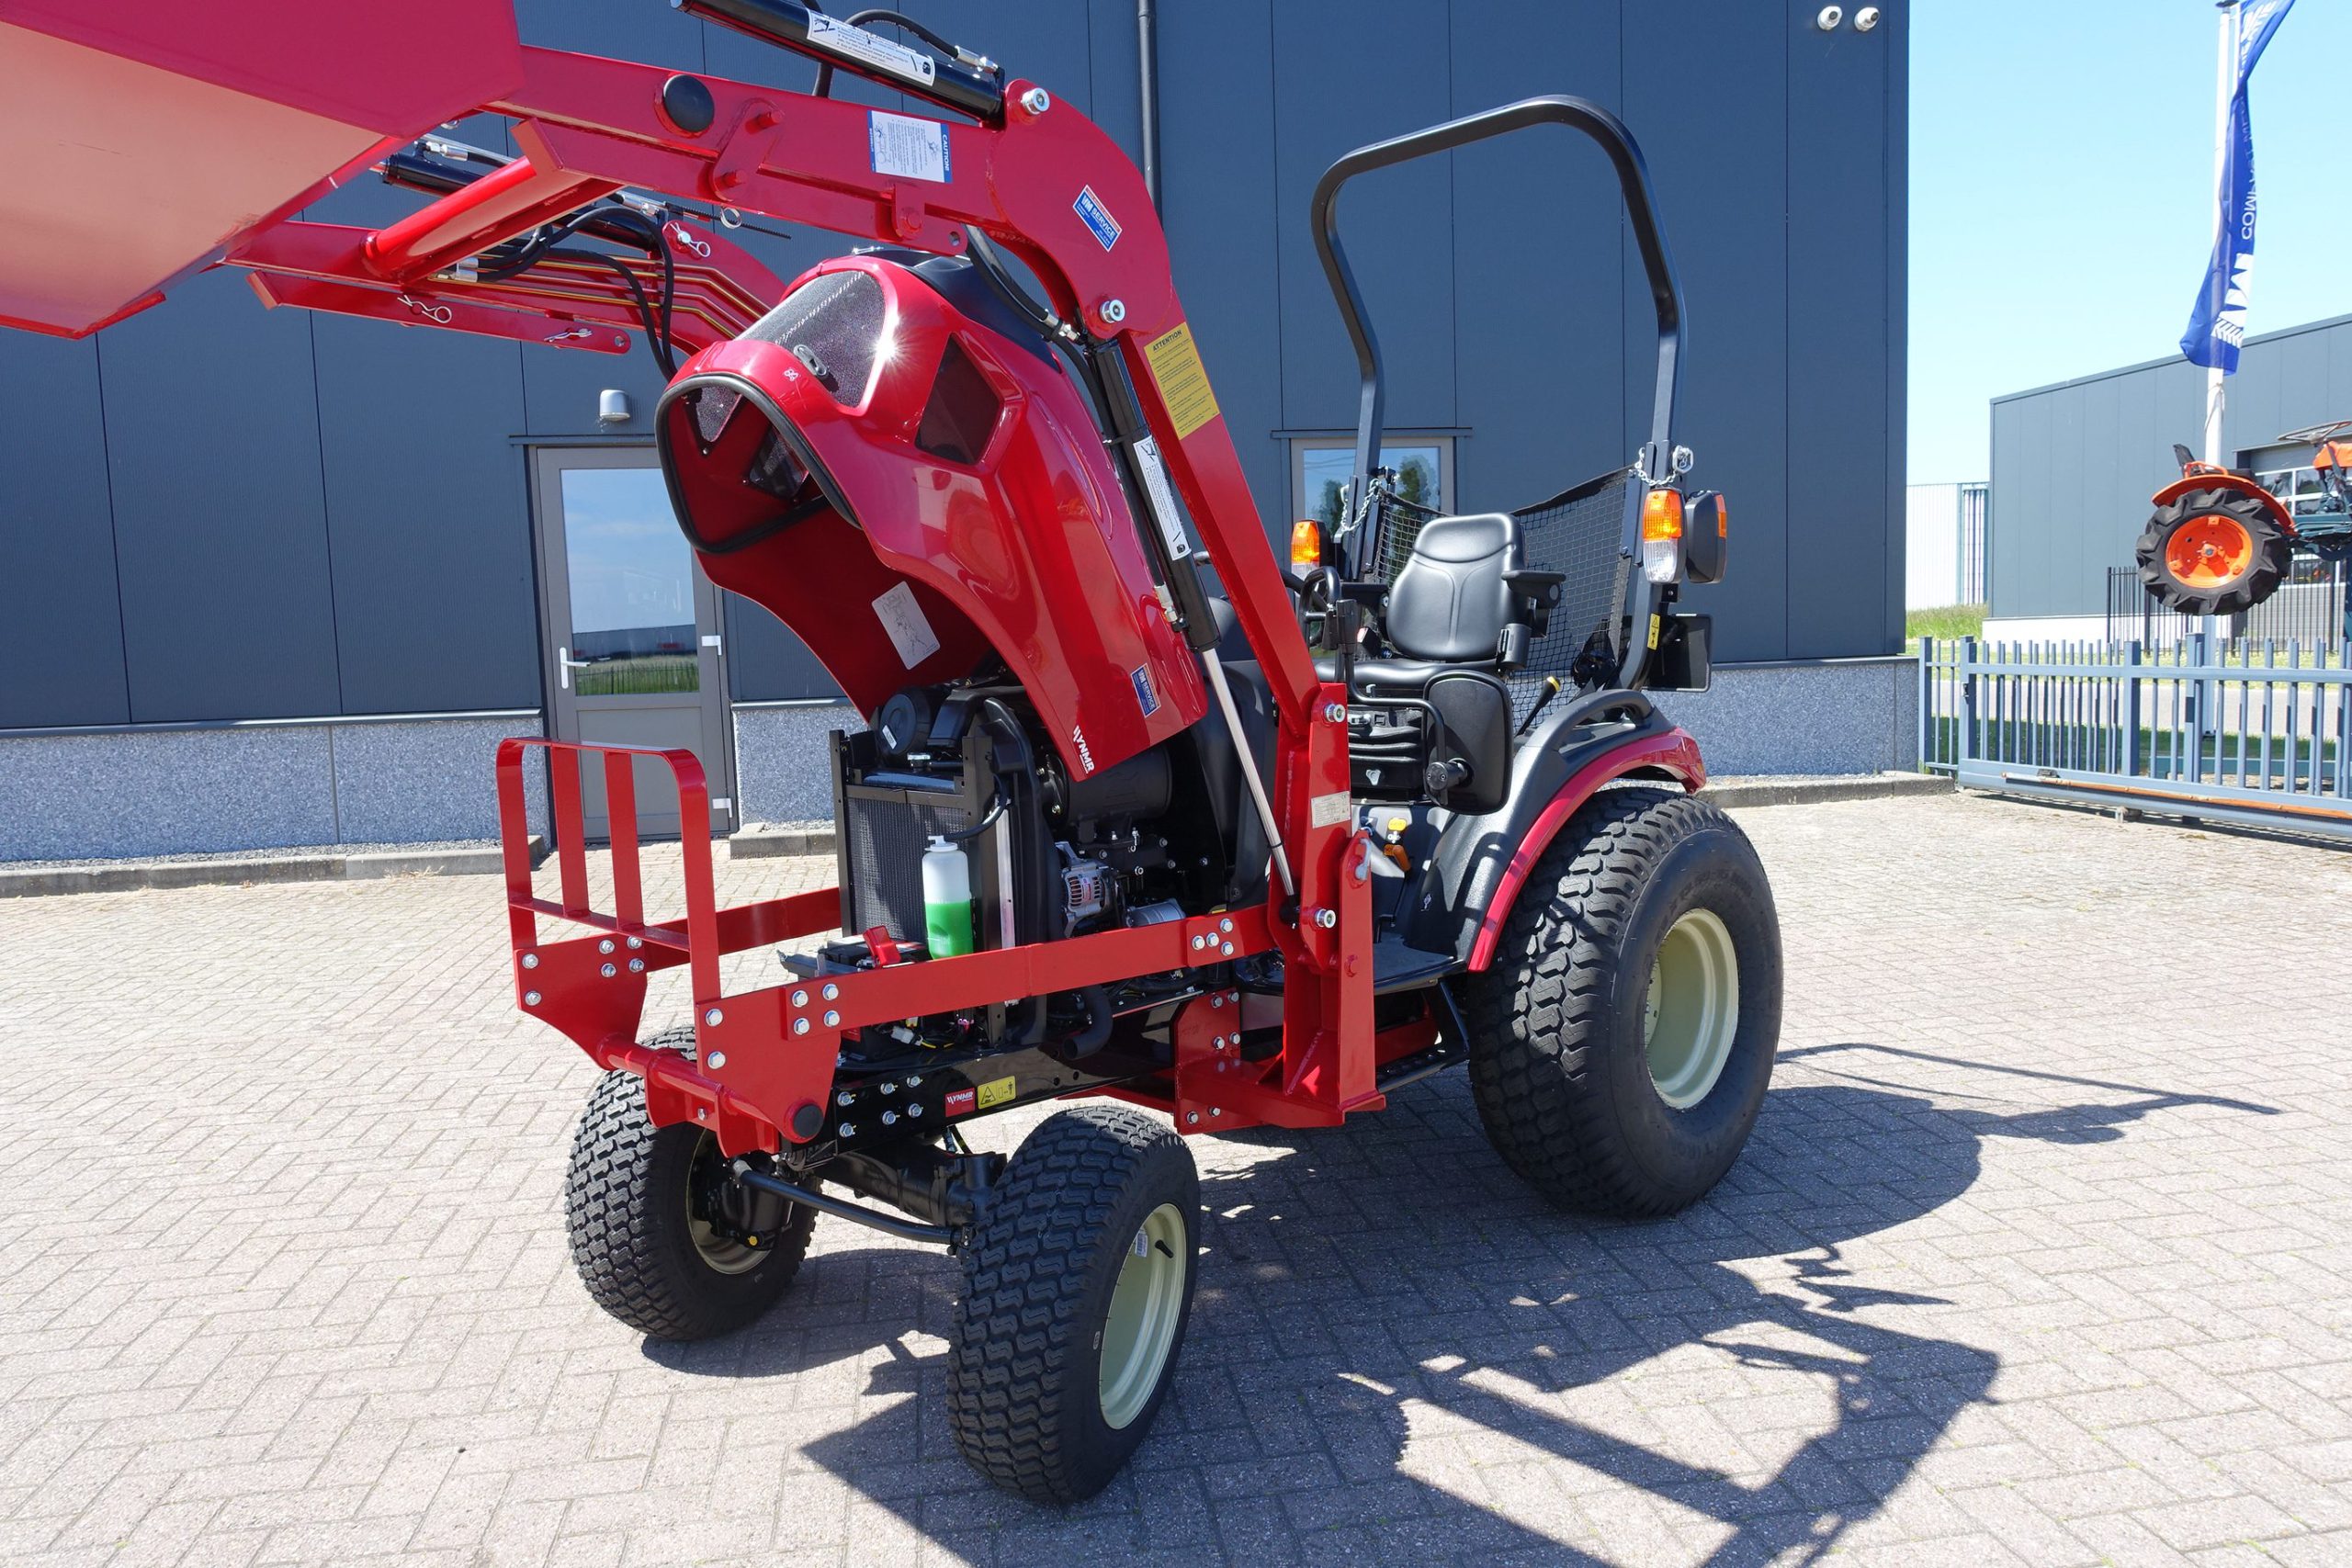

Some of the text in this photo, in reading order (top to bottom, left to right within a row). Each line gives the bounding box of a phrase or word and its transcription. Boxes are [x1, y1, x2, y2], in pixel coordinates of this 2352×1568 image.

[1081, 195, 1094, 213] VM
[1091, 208, 1116, 239] SERVICE
[1152, 329, 1182, 352] ATTENTION
[1141, 682, 1156, 711] SERVICE
